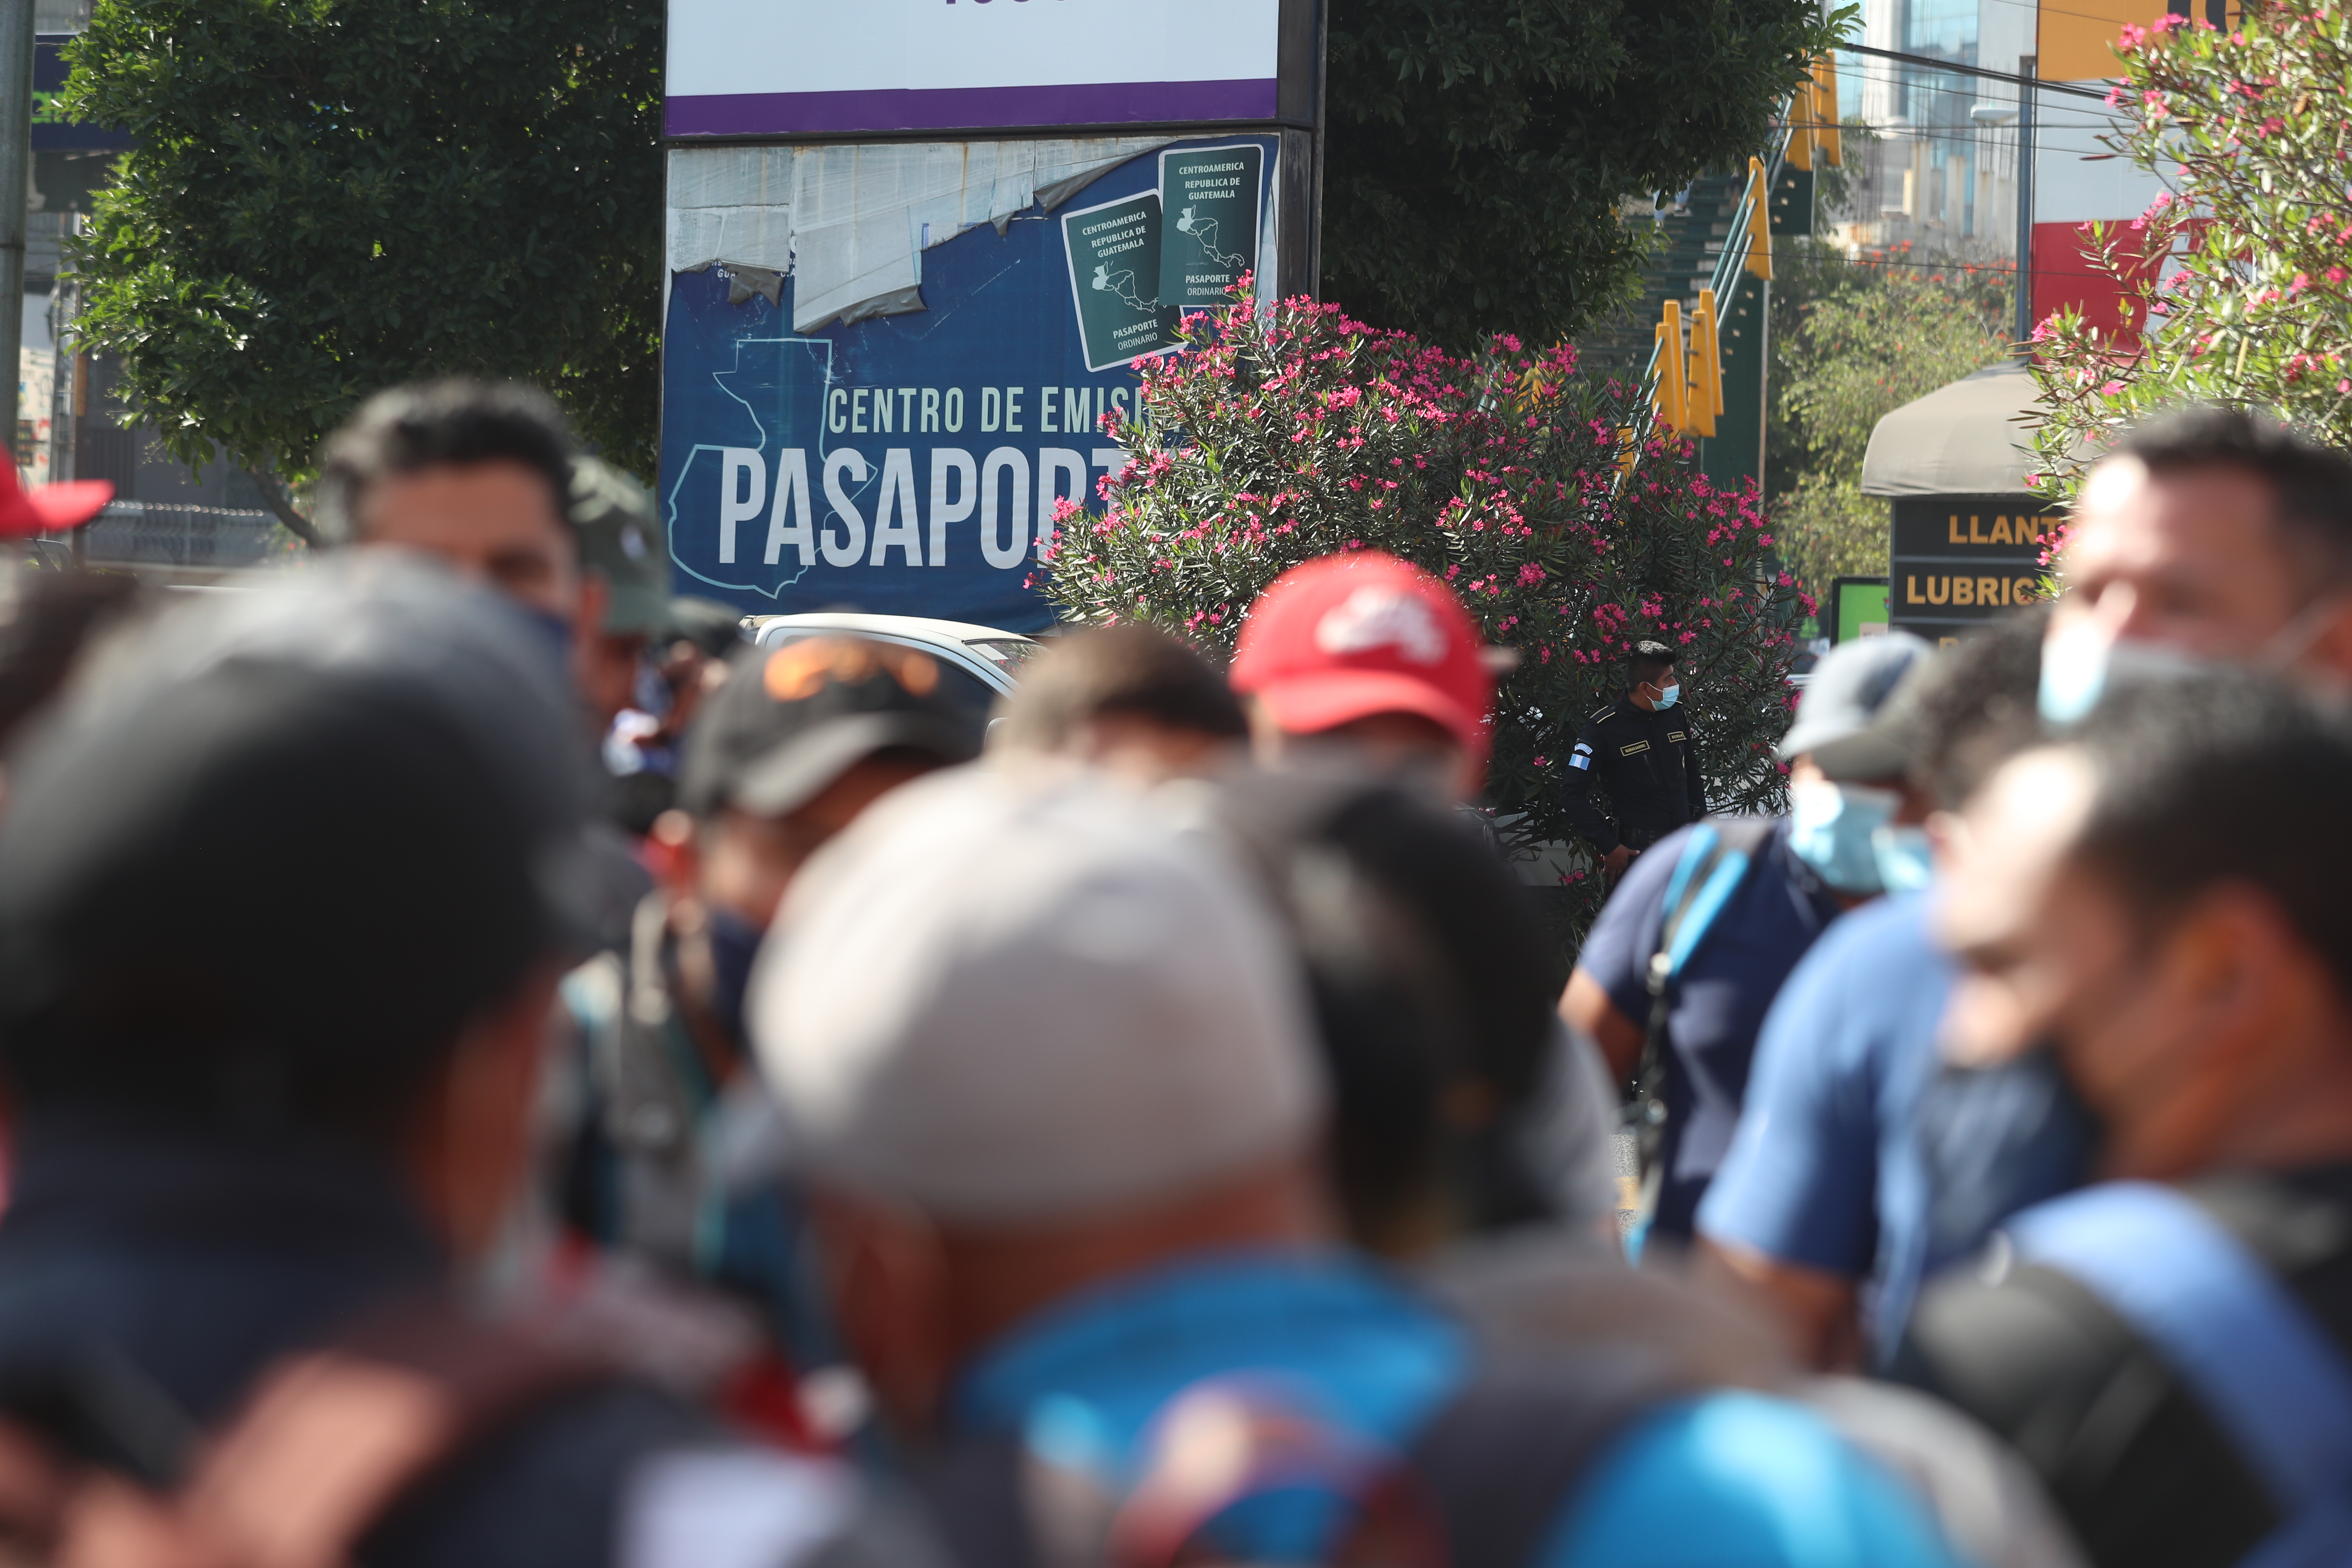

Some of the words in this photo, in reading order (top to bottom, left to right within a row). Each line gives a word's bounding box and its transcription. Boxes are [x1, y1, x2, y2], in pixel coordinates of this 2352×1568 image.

[1179, 162, 1244, 175] CENTROAMERICA
[1185, 178, 1228, 189] REPUBLICA
[1230, 177, 1240, 186] DE
[1188, 190, 1235, 200] GUATEMALA
[1082, 211, 1147, 236] CENTROAMERICA
[1091, 229, 1135, 248] REPUBLICA
[1136, 225, 1146, 236] DE
[1097, 238, 1145, 258] GUATEMALA
[1185, 274, 1230, 284] PASAPORTE
[1187, 287, 1227, 296] ORDINARIO
[1112, 319, 1158, 339] PASAPORTE
[1118, 332, 1158, 351] ORDINARIO
[829, 387, 964, 433] CENTRO
[980, 387, 1024, 432] DE
[1041, 386, 1180, 433] EMISI
[719, 446, 1188, 570] PASAPORT
[1949, 514, 2076, 545] LLANT
[1907, 575, 2045, 606] LUBRIC
